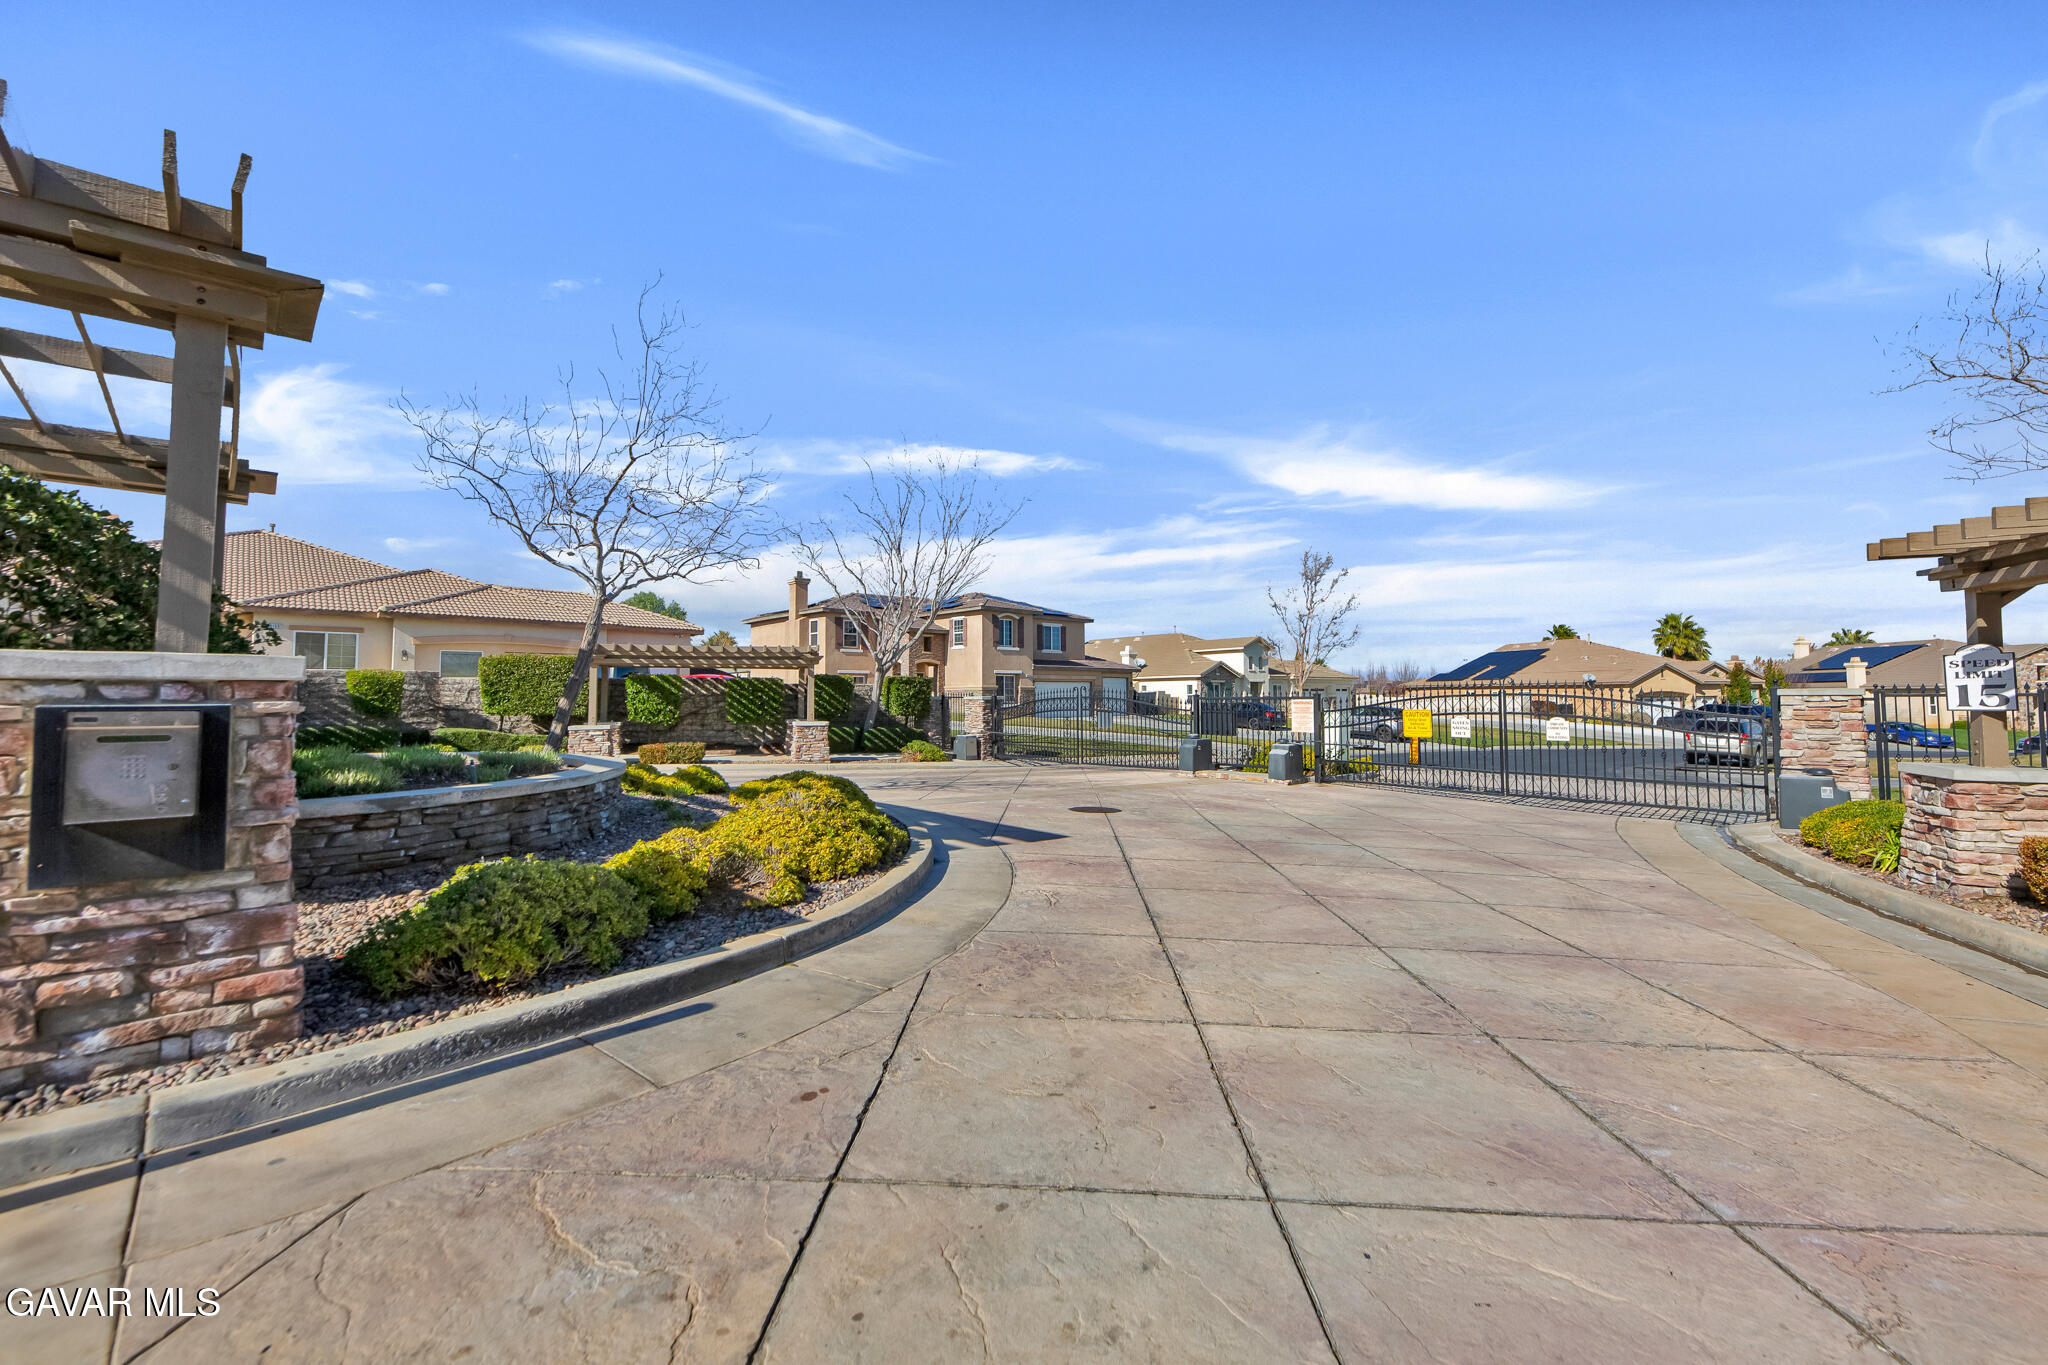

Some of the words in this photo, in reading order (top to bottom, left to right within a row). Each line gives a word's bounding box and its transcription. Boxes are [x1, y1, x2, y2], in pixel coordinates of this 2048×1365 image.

[1949, 659, 2009, 669] SPEED
[1955, 671, 2005, 679] LIMIT
[1956, 684, 2010, 707] 15
